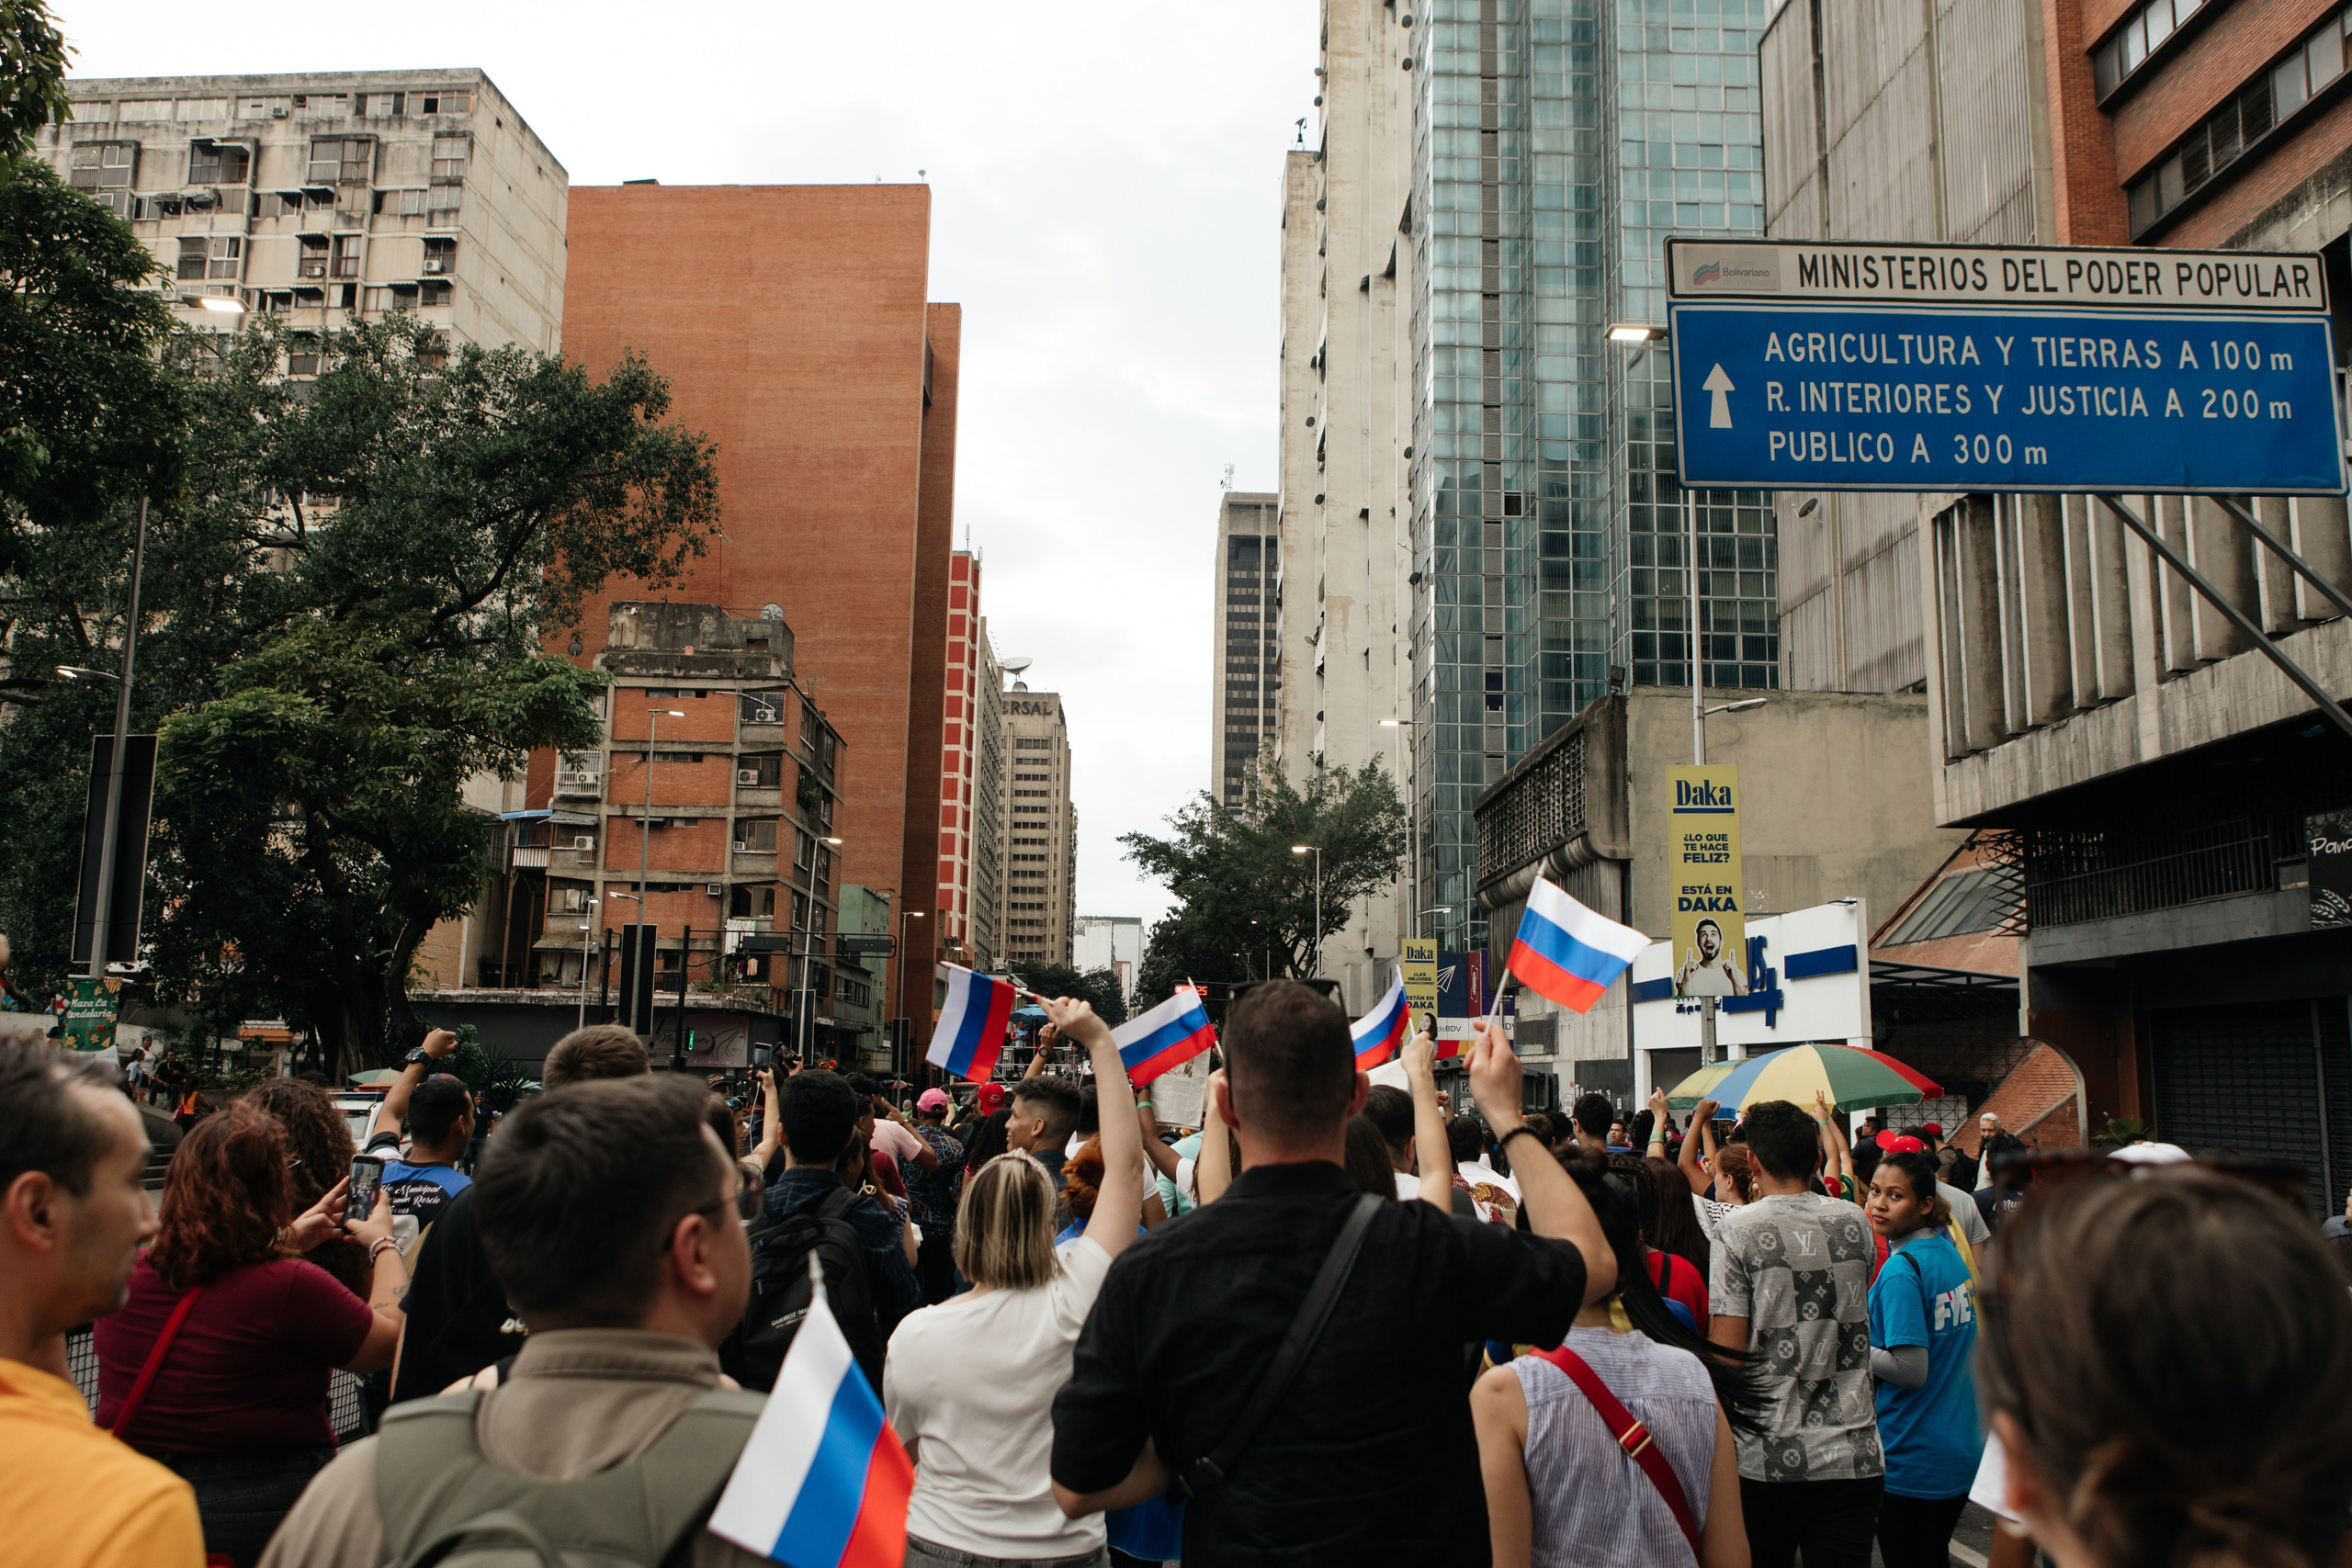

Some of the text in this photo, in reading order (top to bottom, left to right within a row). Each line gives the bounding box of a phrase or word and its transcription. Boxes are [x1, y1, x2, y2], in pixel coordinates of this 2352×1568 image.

[1723, 266, 1770, 277] Bolivariano
[1798, 253, 2312, 298] MINISTERIOS DEL PODER POPULAR
[1764, 332, 2293, 370] AGRICULTURA Y TIERRAS A 100 m
[1767, 381, 2292, 419] R. INTERIORES Y JUSTICIA A 200 m
[1769, 431, 2048, 465] PUBLICO A 300 m
[1675, 779, 1732, 806] Daka
[1683, 833, 1728, 842] ¿LO QUE
[1683, 842, 1729, 852] TE HACE
[1683, 852, 1731, 863] FELIZ?
[1681, 883, 1733, 895] ESTÁ EN
[1678, 897, 1738, 912] DAKA
[1406, 945, 1433, 960] Daka
[95, 998, 108, 1007] La
[394, 1184, 443, 1197] Municipal
